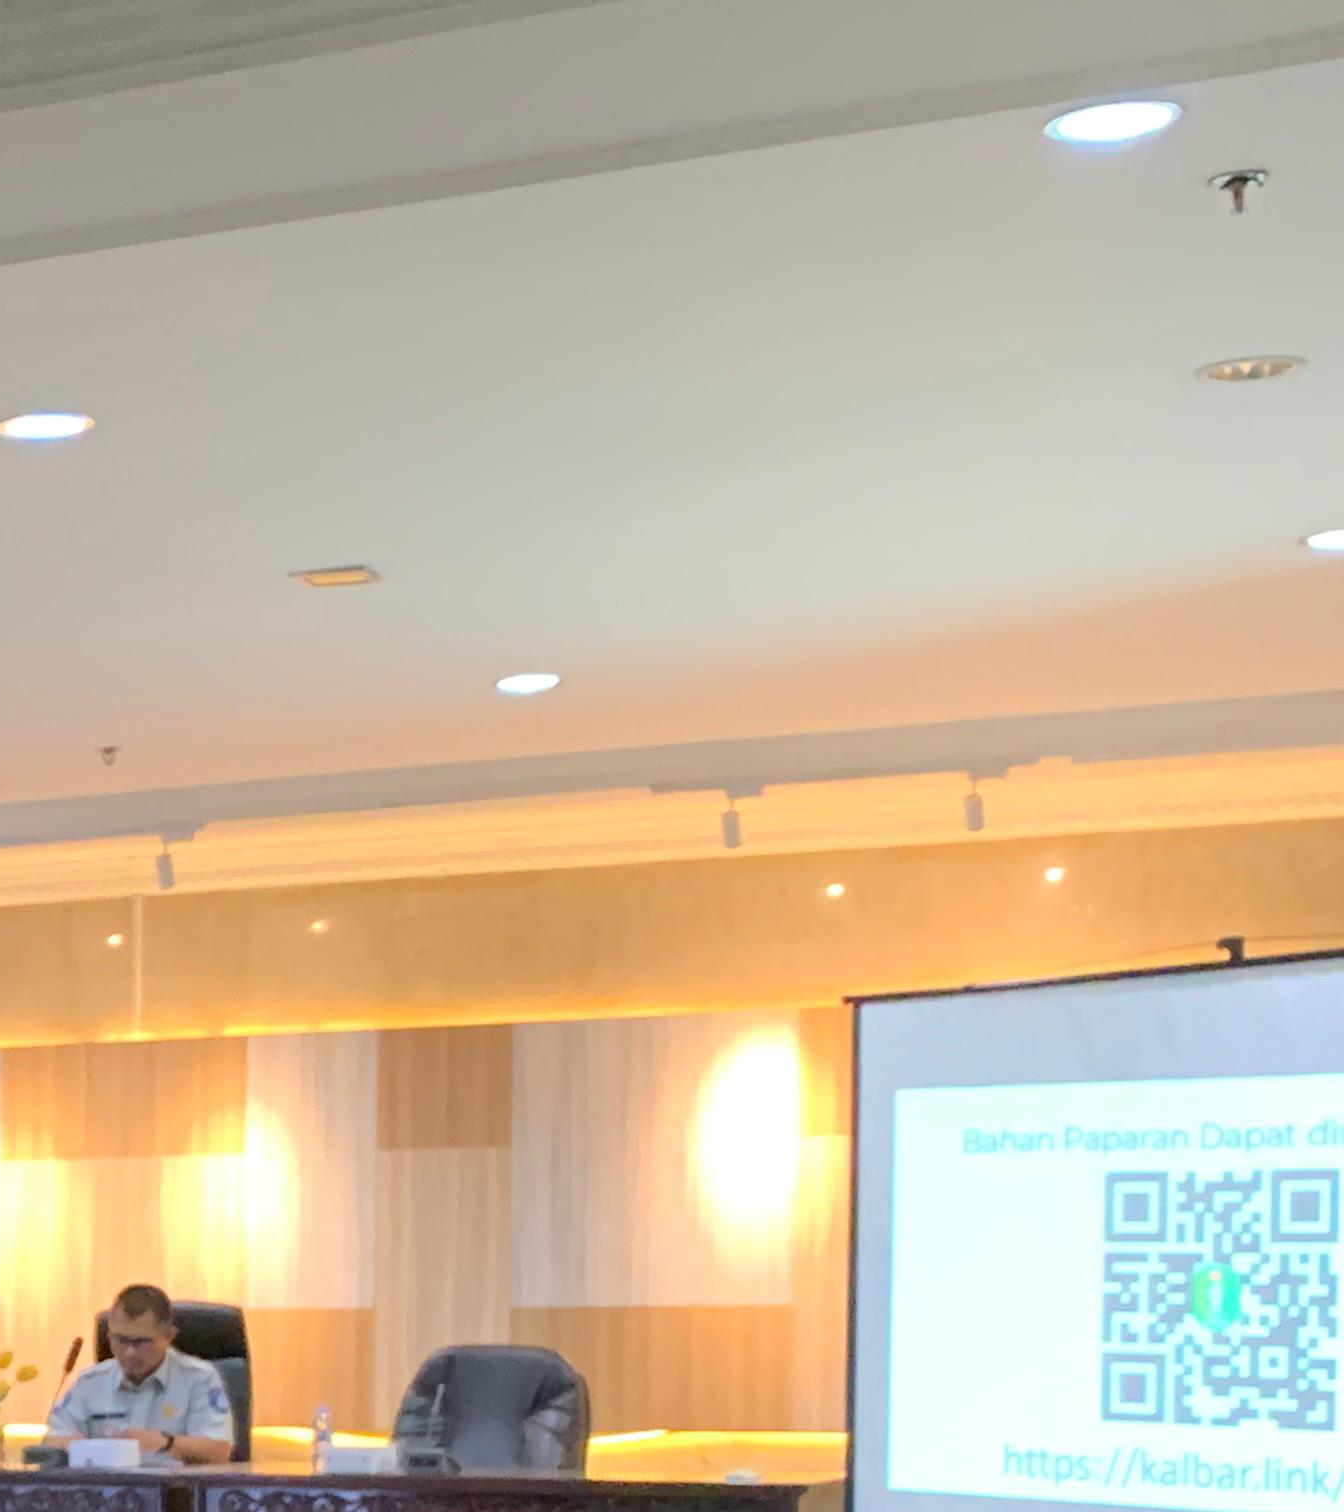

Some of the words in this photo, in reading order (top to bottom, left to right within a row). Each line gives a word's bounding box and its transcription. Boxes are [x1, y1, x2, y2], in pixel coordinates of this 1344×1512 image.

[963, 1127, 1053, 1154] Bahan
[1064, 1124, 1189, 1156] Paparan
[1199, 1121, 1296, 1153] Dapat
[1306, 1116, 1344, 1147] di
